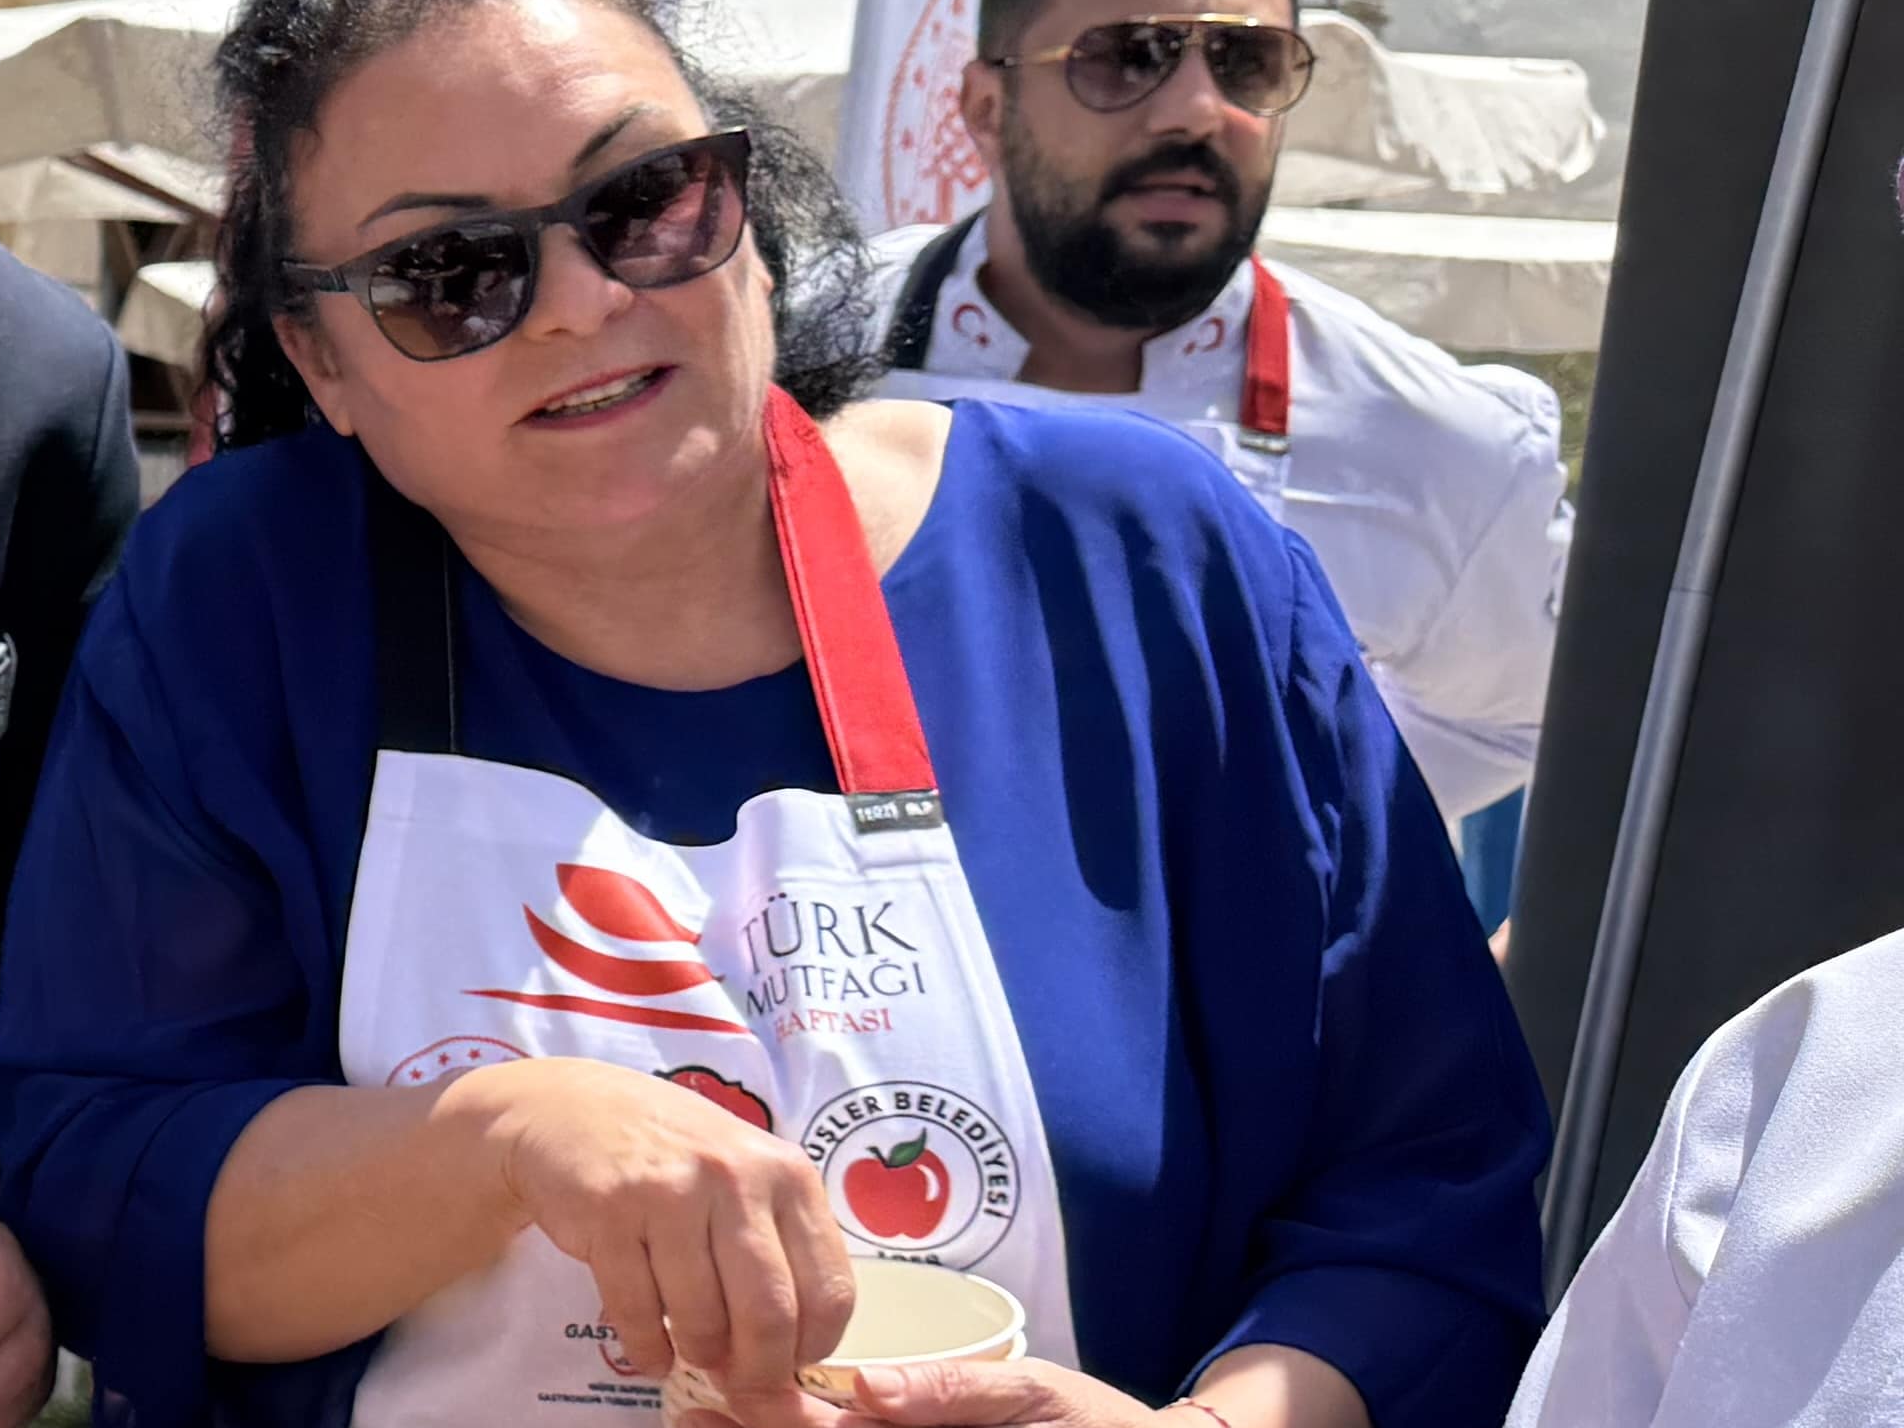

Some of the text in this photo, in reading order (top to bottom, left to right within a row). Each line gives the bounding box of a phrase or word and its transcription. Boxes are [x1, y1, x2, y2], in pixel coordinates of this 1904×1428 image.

[742, 892, 920, 975] TÜRK
[746, 958, 927, 1017] MUTFAĞI
[807, 1092, 1013, 1220] ÜŞLER BELEDİYESİ
